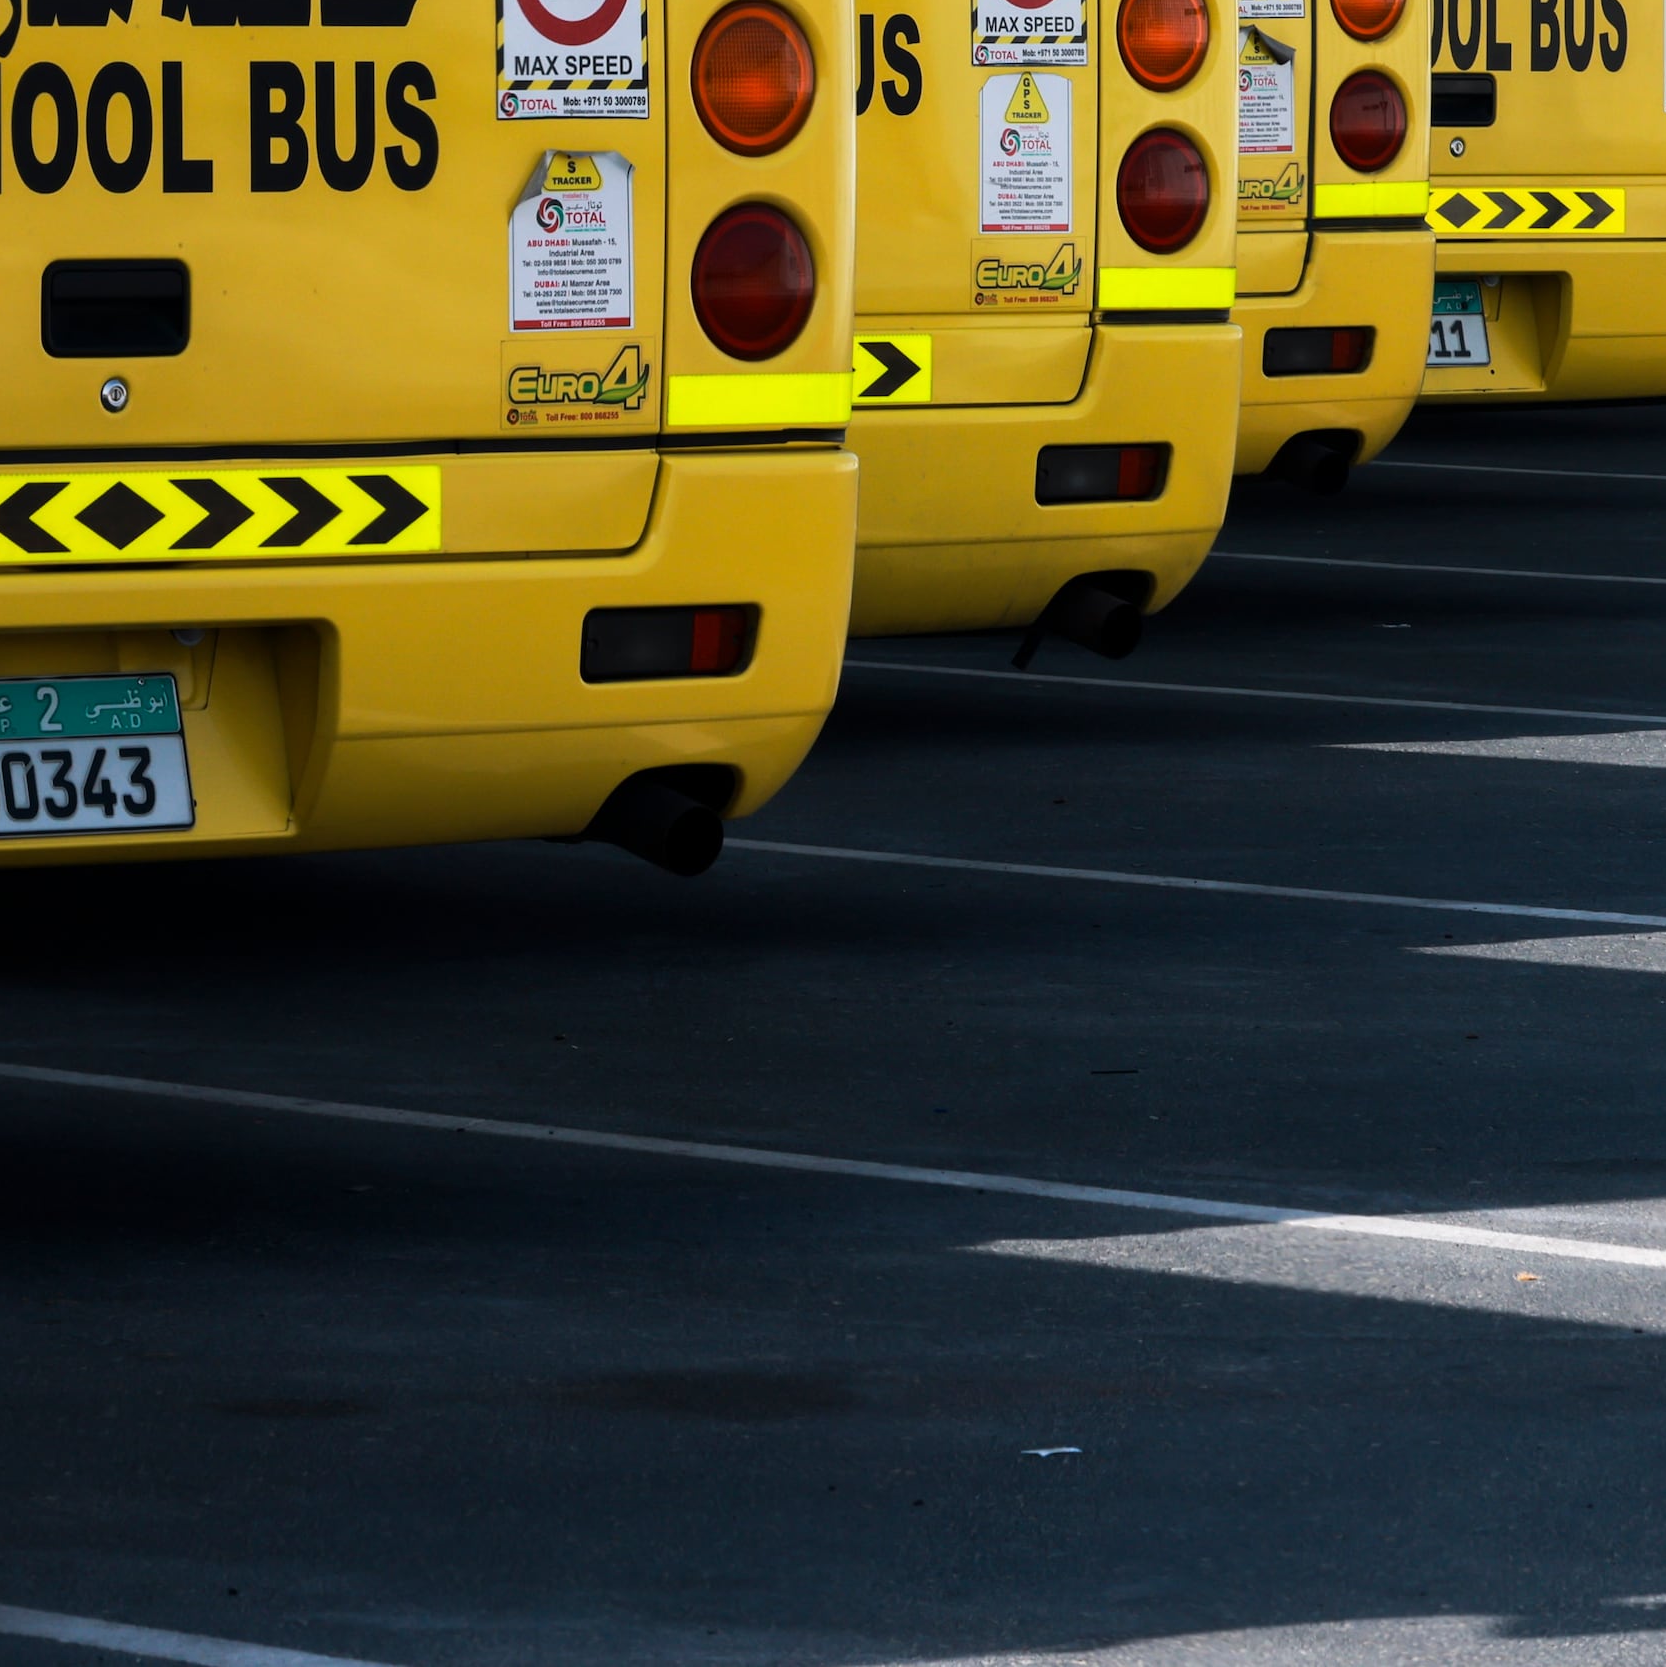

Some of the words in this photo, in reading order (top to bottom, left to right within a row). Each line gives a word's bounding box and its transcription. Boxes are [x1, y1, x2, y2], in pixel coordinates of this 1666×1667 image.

[986, 17, 1019, 32] MAX
[1023, 17, 1074, 32] SPEED
[990, 51, 1018, 60] TOTAL
[514, 56, 559, 76] MAX
[565, 55, 633, 75] SPEED
[1253, 78, 1277, 86] TOTAL
[520, 99, 557, 110] TOTAL
[563, 97, 581, 106] Mob:
[583, 97, 601, 106] +971
[603, 97, 612, 105] 50
[615, 97, 646, 106] 3000789
[250, 60, 439, 193] BUS
[1022, 140, 1051, 149] TOTAL
[552, 177, 591, 185] TRACKER
[565, 212, 606, 224] TOTAL
[36, 687, 62, 731] 2
